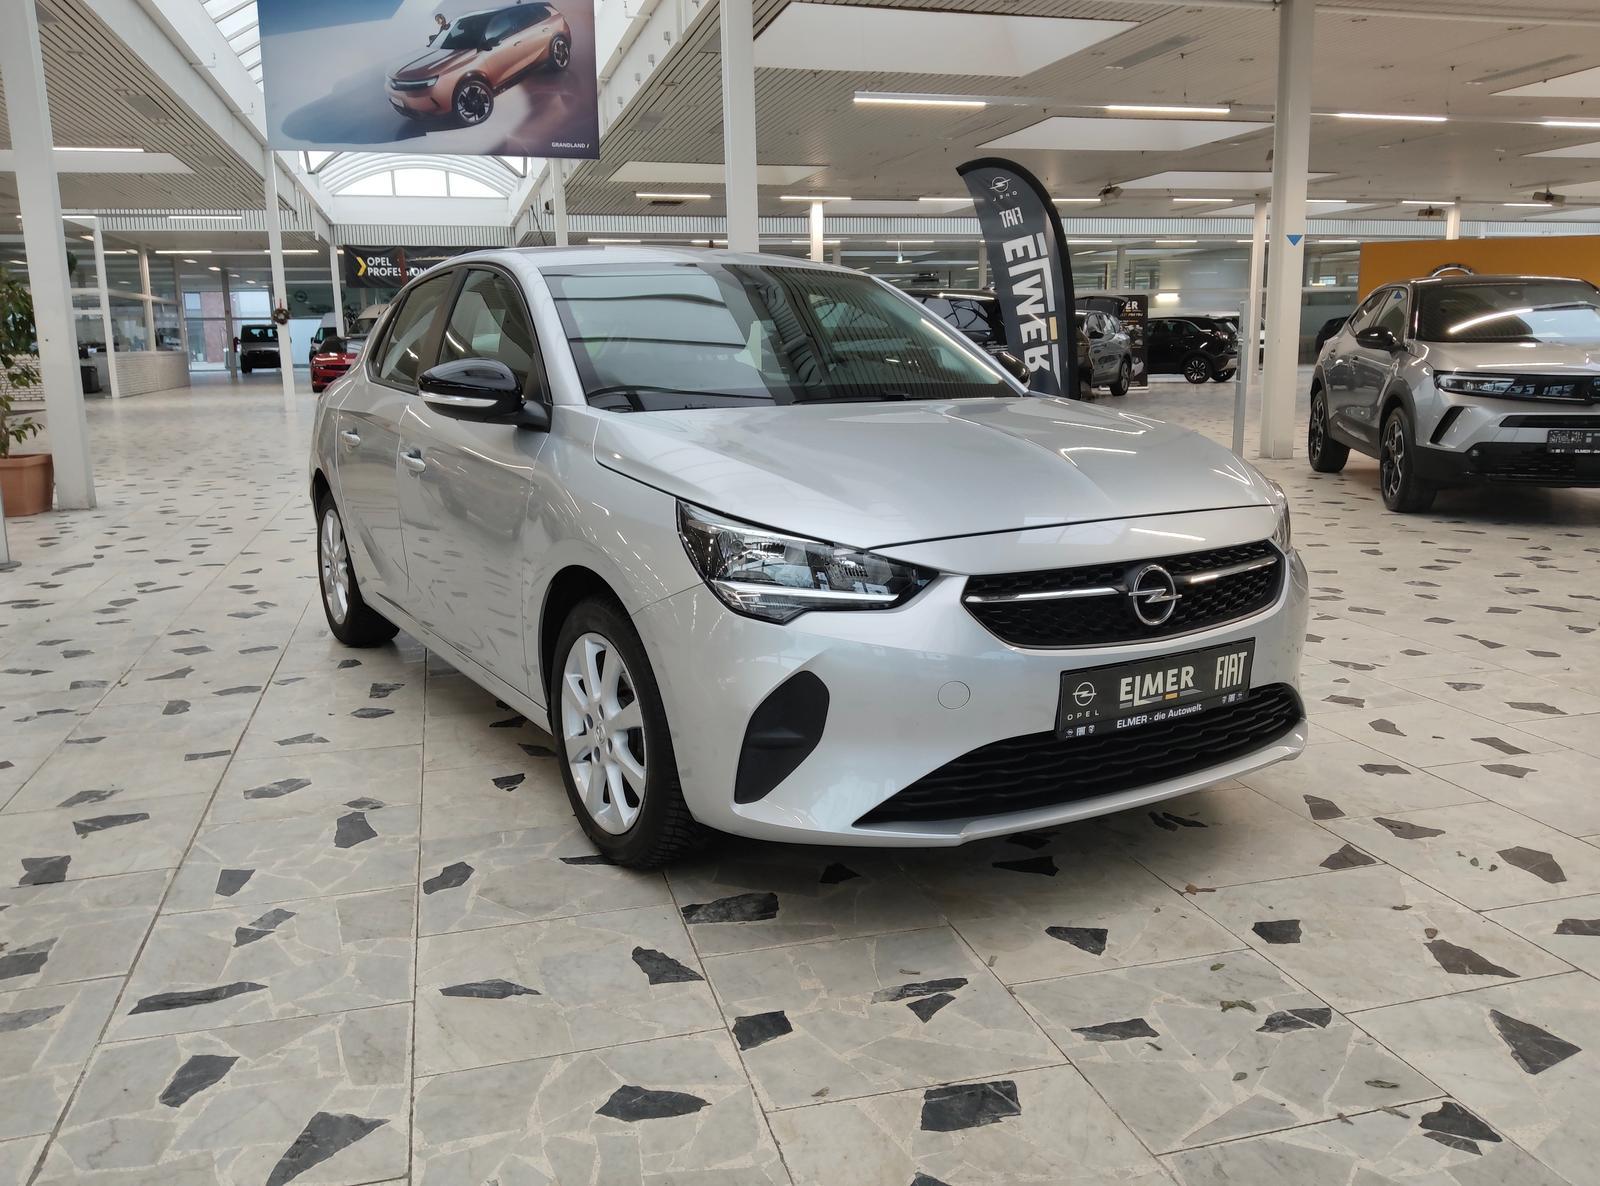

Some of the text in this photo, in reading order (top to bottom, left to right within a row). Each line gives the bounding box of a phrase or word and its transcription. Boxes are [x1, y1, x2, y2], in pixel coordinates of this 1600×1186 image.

[367, 256, 392, 267] OPEL
[1215, 652, 1247, 690] FIAT
[1120, 666, 1194, 706] ELMER
[1066, 709, 1100, 721] OPEL
[1116, 714, 1148, 729] ELMER
[1153, 711, 1166, 721] die
[1167, 703, 1202, 719] Autowelt
